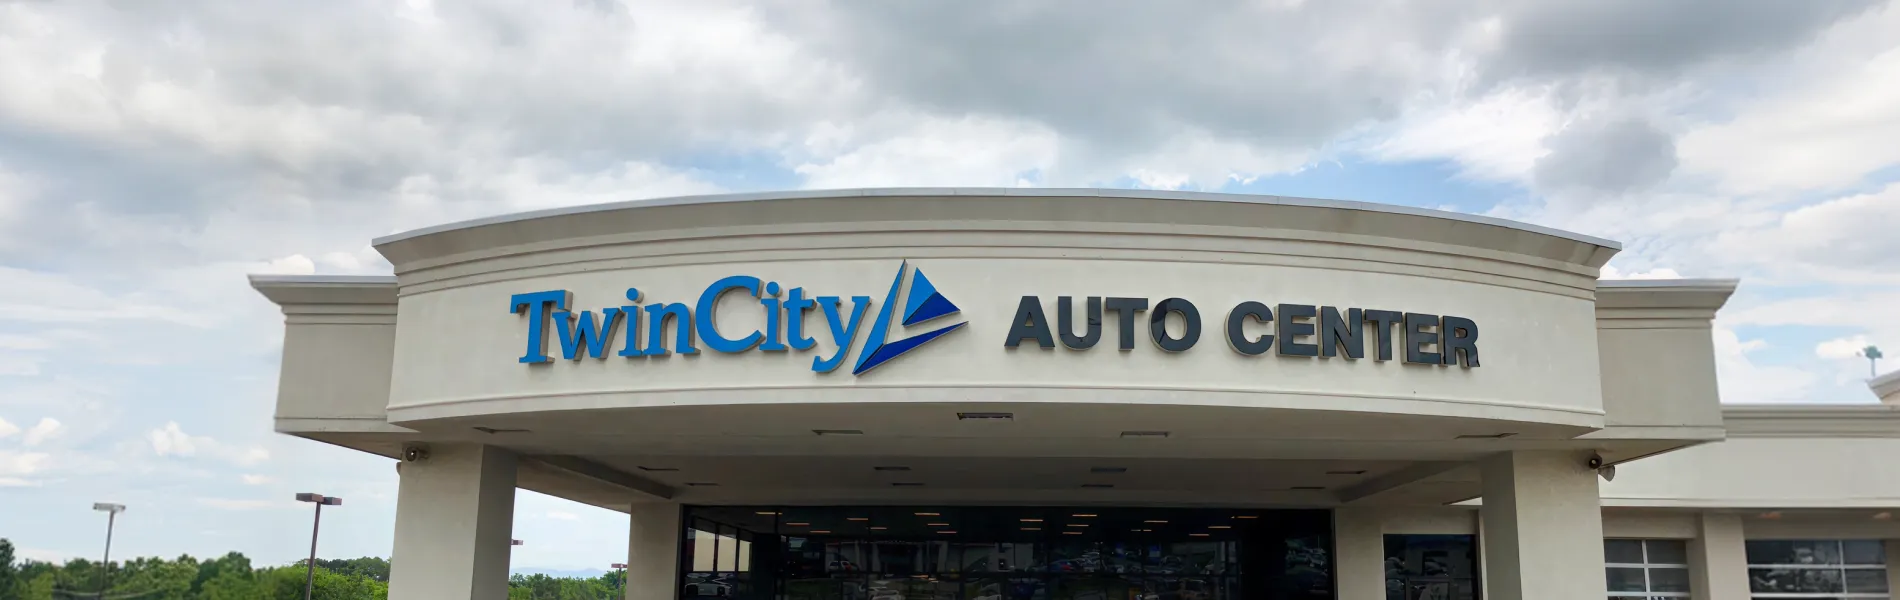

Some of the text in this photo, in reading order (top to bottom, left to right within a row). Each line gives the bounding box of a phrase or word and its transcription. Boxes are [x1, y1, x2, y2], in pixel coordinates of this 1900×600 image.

[510, 275, 1480, 372] TwinCity AUTO CENTER
